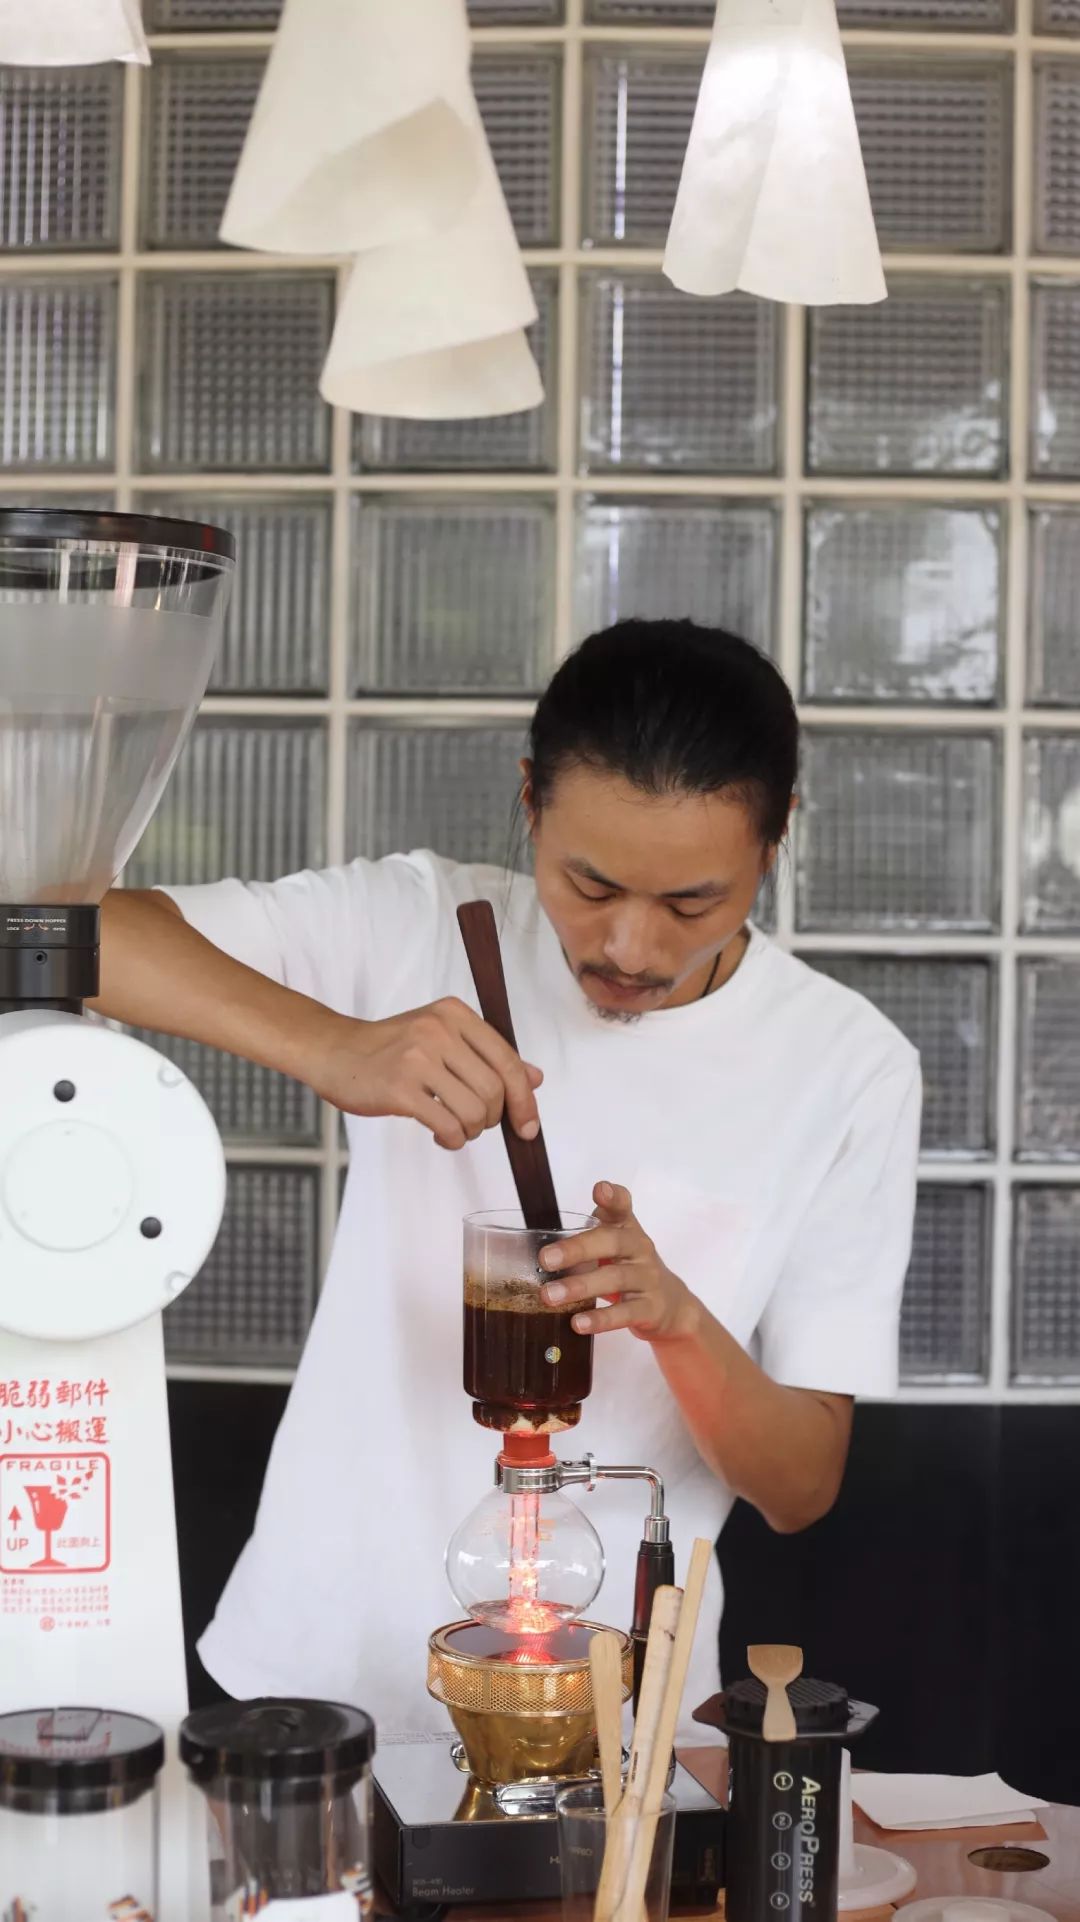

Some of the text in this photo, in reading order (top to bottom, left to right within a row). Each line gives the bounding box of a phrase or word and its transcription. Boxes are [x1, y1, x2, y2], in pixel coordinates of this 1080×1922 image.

[0, 1378, 109, 1408] 脆弱郵件
[0, 1416, 109, 1444] 小心搬運
[6, 1460, 99, 1471] FRAGILE
[6, 1537, 29, 1551] UP
[412, 1884, 475, 1897] Beam Heater
